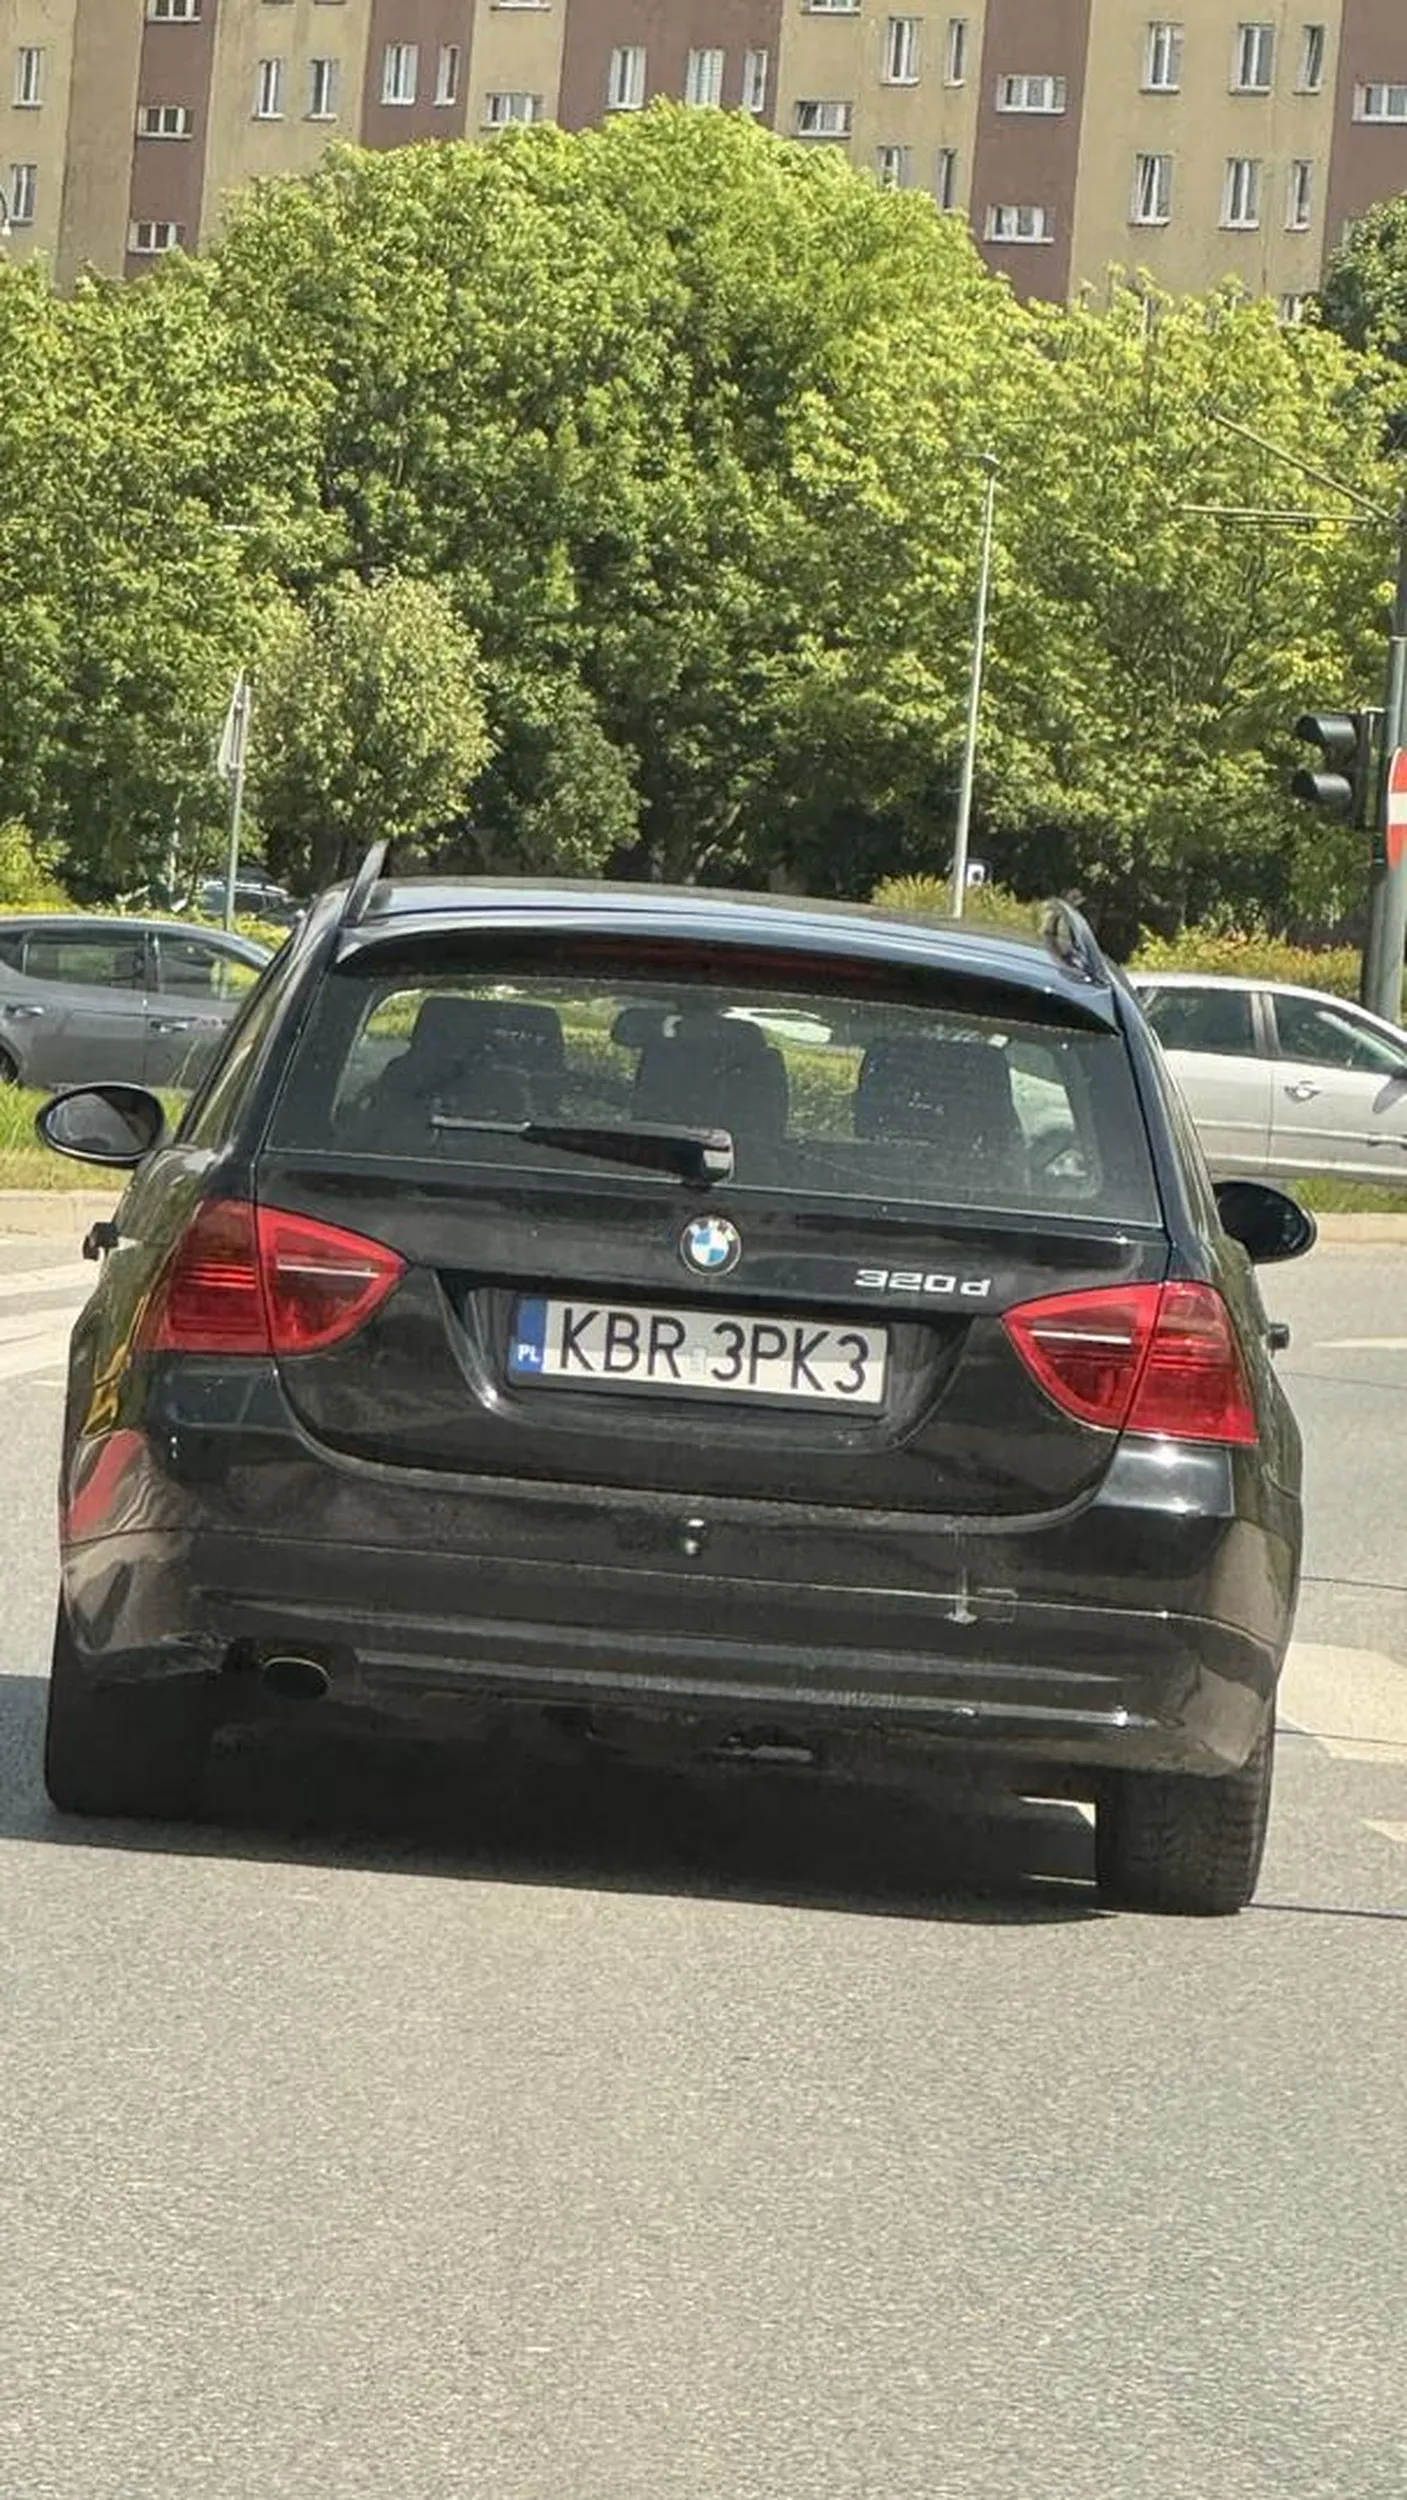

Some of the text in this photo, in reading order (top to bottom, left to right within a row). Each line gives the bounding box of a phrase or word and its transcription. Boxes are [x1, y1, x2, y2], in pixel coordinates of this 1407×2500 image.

[854, 1269, 991, 1297] 320d
[517, 1343, 541, 1363] PL
[560, 1307, 869, 1394] KBR 3PK3
